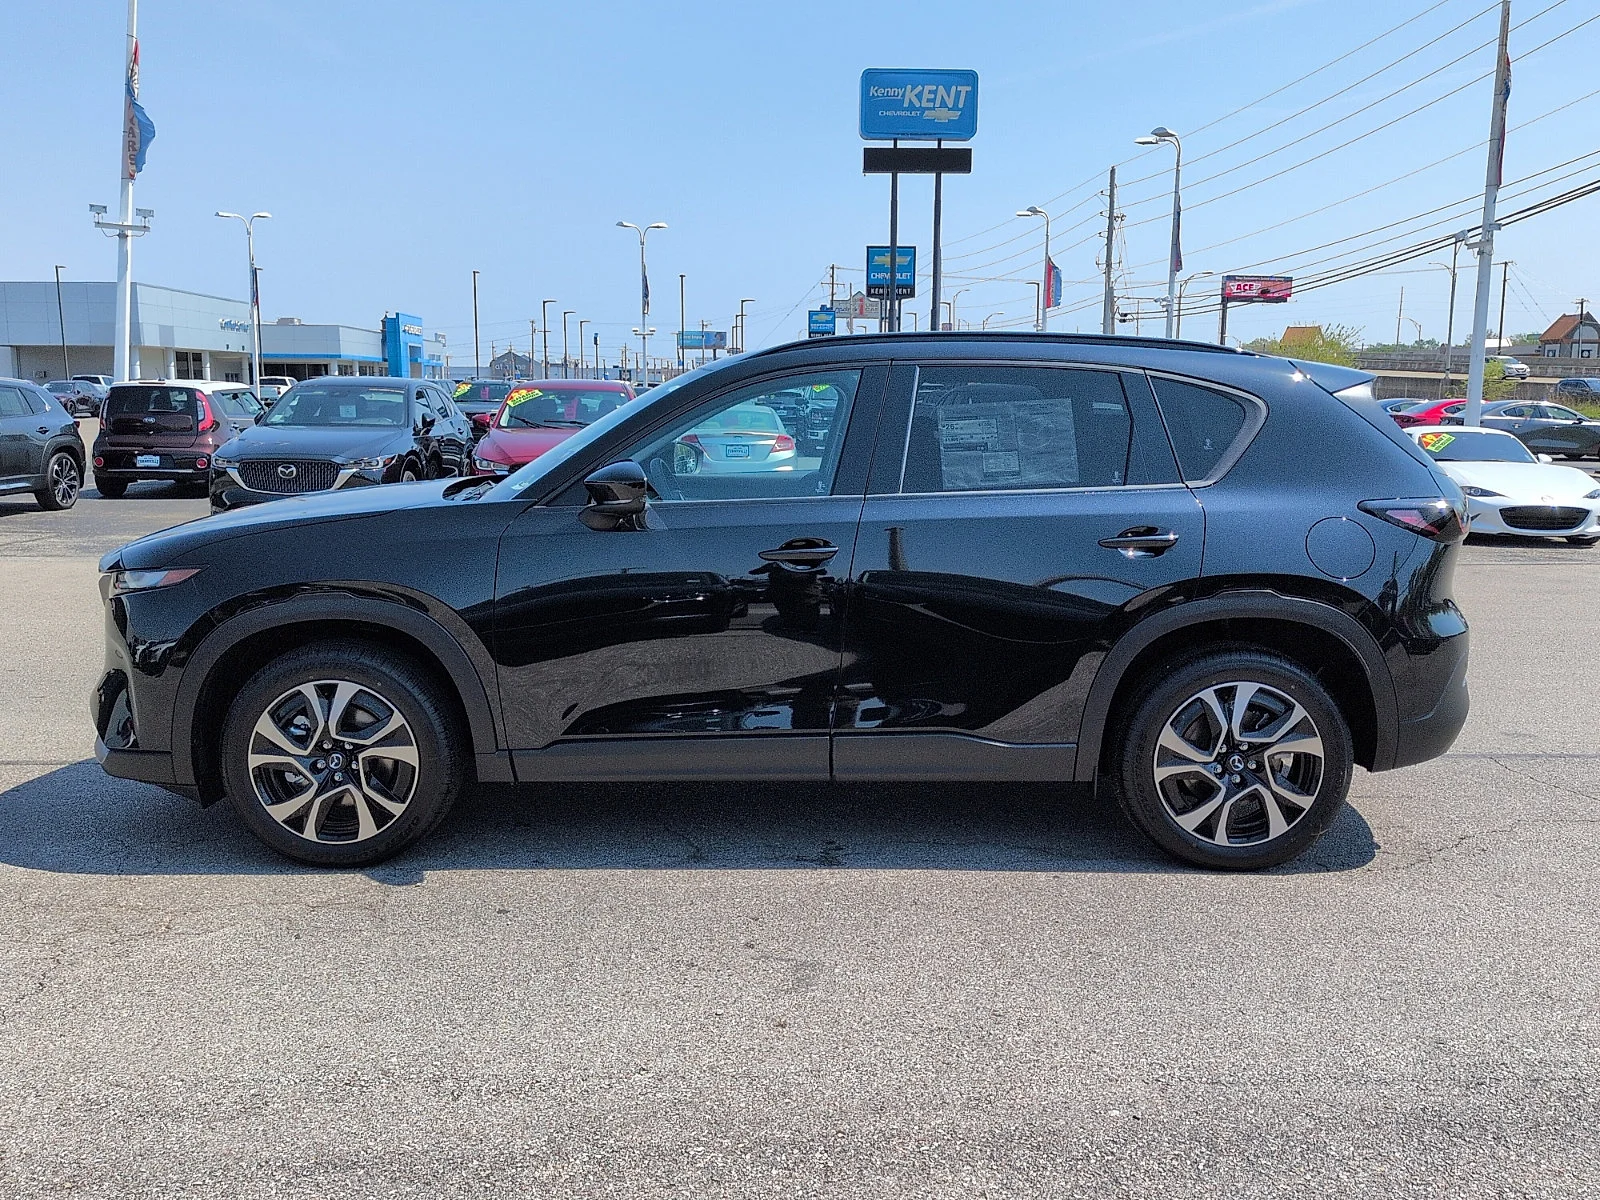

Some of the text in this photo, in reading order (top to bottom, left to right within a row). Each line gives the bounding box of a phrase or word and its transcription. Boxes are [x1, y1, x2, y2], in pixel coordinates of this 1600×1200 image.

[869, 84, 972, 108] Kenny KENT
[1236, 283, 1254, 292] ACE
